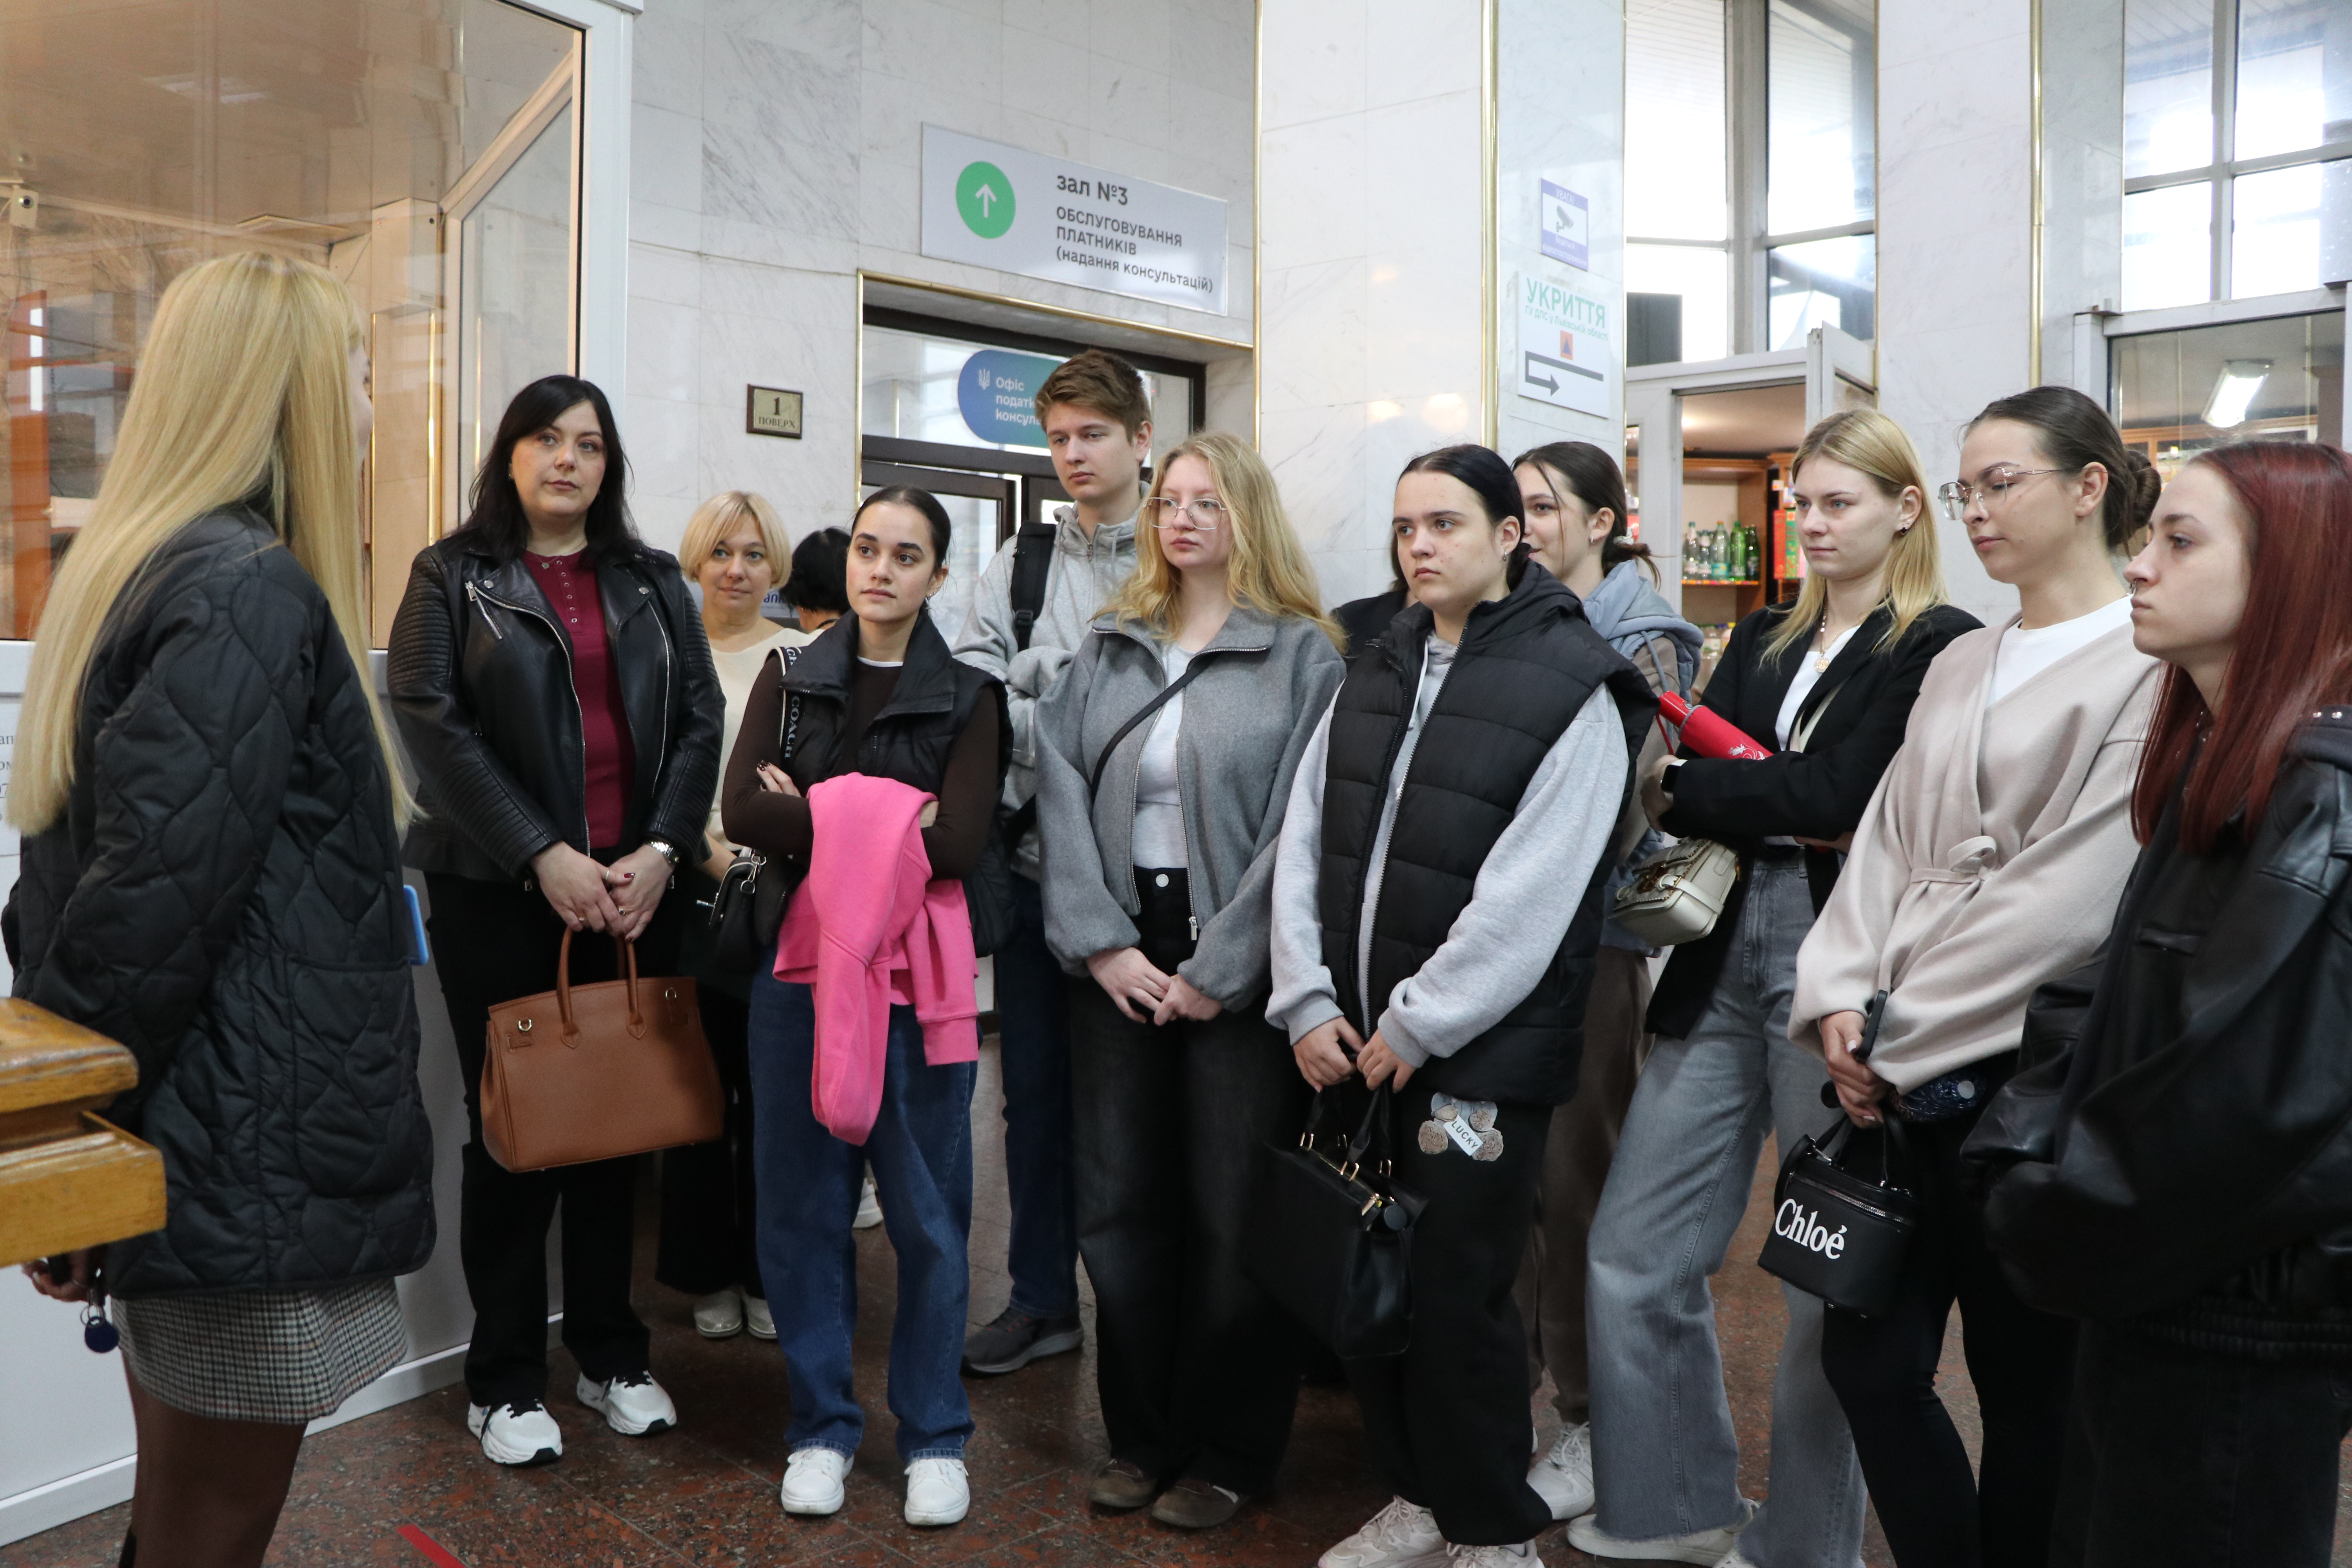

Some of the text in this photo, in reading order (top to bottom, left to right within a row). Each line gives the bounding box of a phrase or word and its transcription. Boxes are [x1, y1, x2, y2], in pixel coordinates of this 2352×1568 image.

[1098, 181, 1128, 205] №3
[1556, 189, 1575, 205] УВАГА!
[1056, 206, 1182, 247] ОБСЛУГОВУВАННЯ
[1057, 226, 1137, 256] ПЛАТНИКІВ
[1056, 245, 1213, 293] (надання консультацій)
[1526, 277, 1605, 328] УКРИТТЯ
[1526, 305, 1533, 315] ГУ
[1535, 309, 1548, 320] ДПС
[1555, 316, 1586, 334] Львівській
[996, 376, 1025, 392] Офіс
[773, 397, 780, 416] 1
[996, 394, 1035, 408] податк
[759, 416, 795, 428] ПОВЕРХ
[996, 408, 1041, 426] консуль
[785, 695, 800, 758] COACH
[1451, 1120, 1479, 1149] LUCKY
[1775, 1198, 1847, 1259] Chloé
